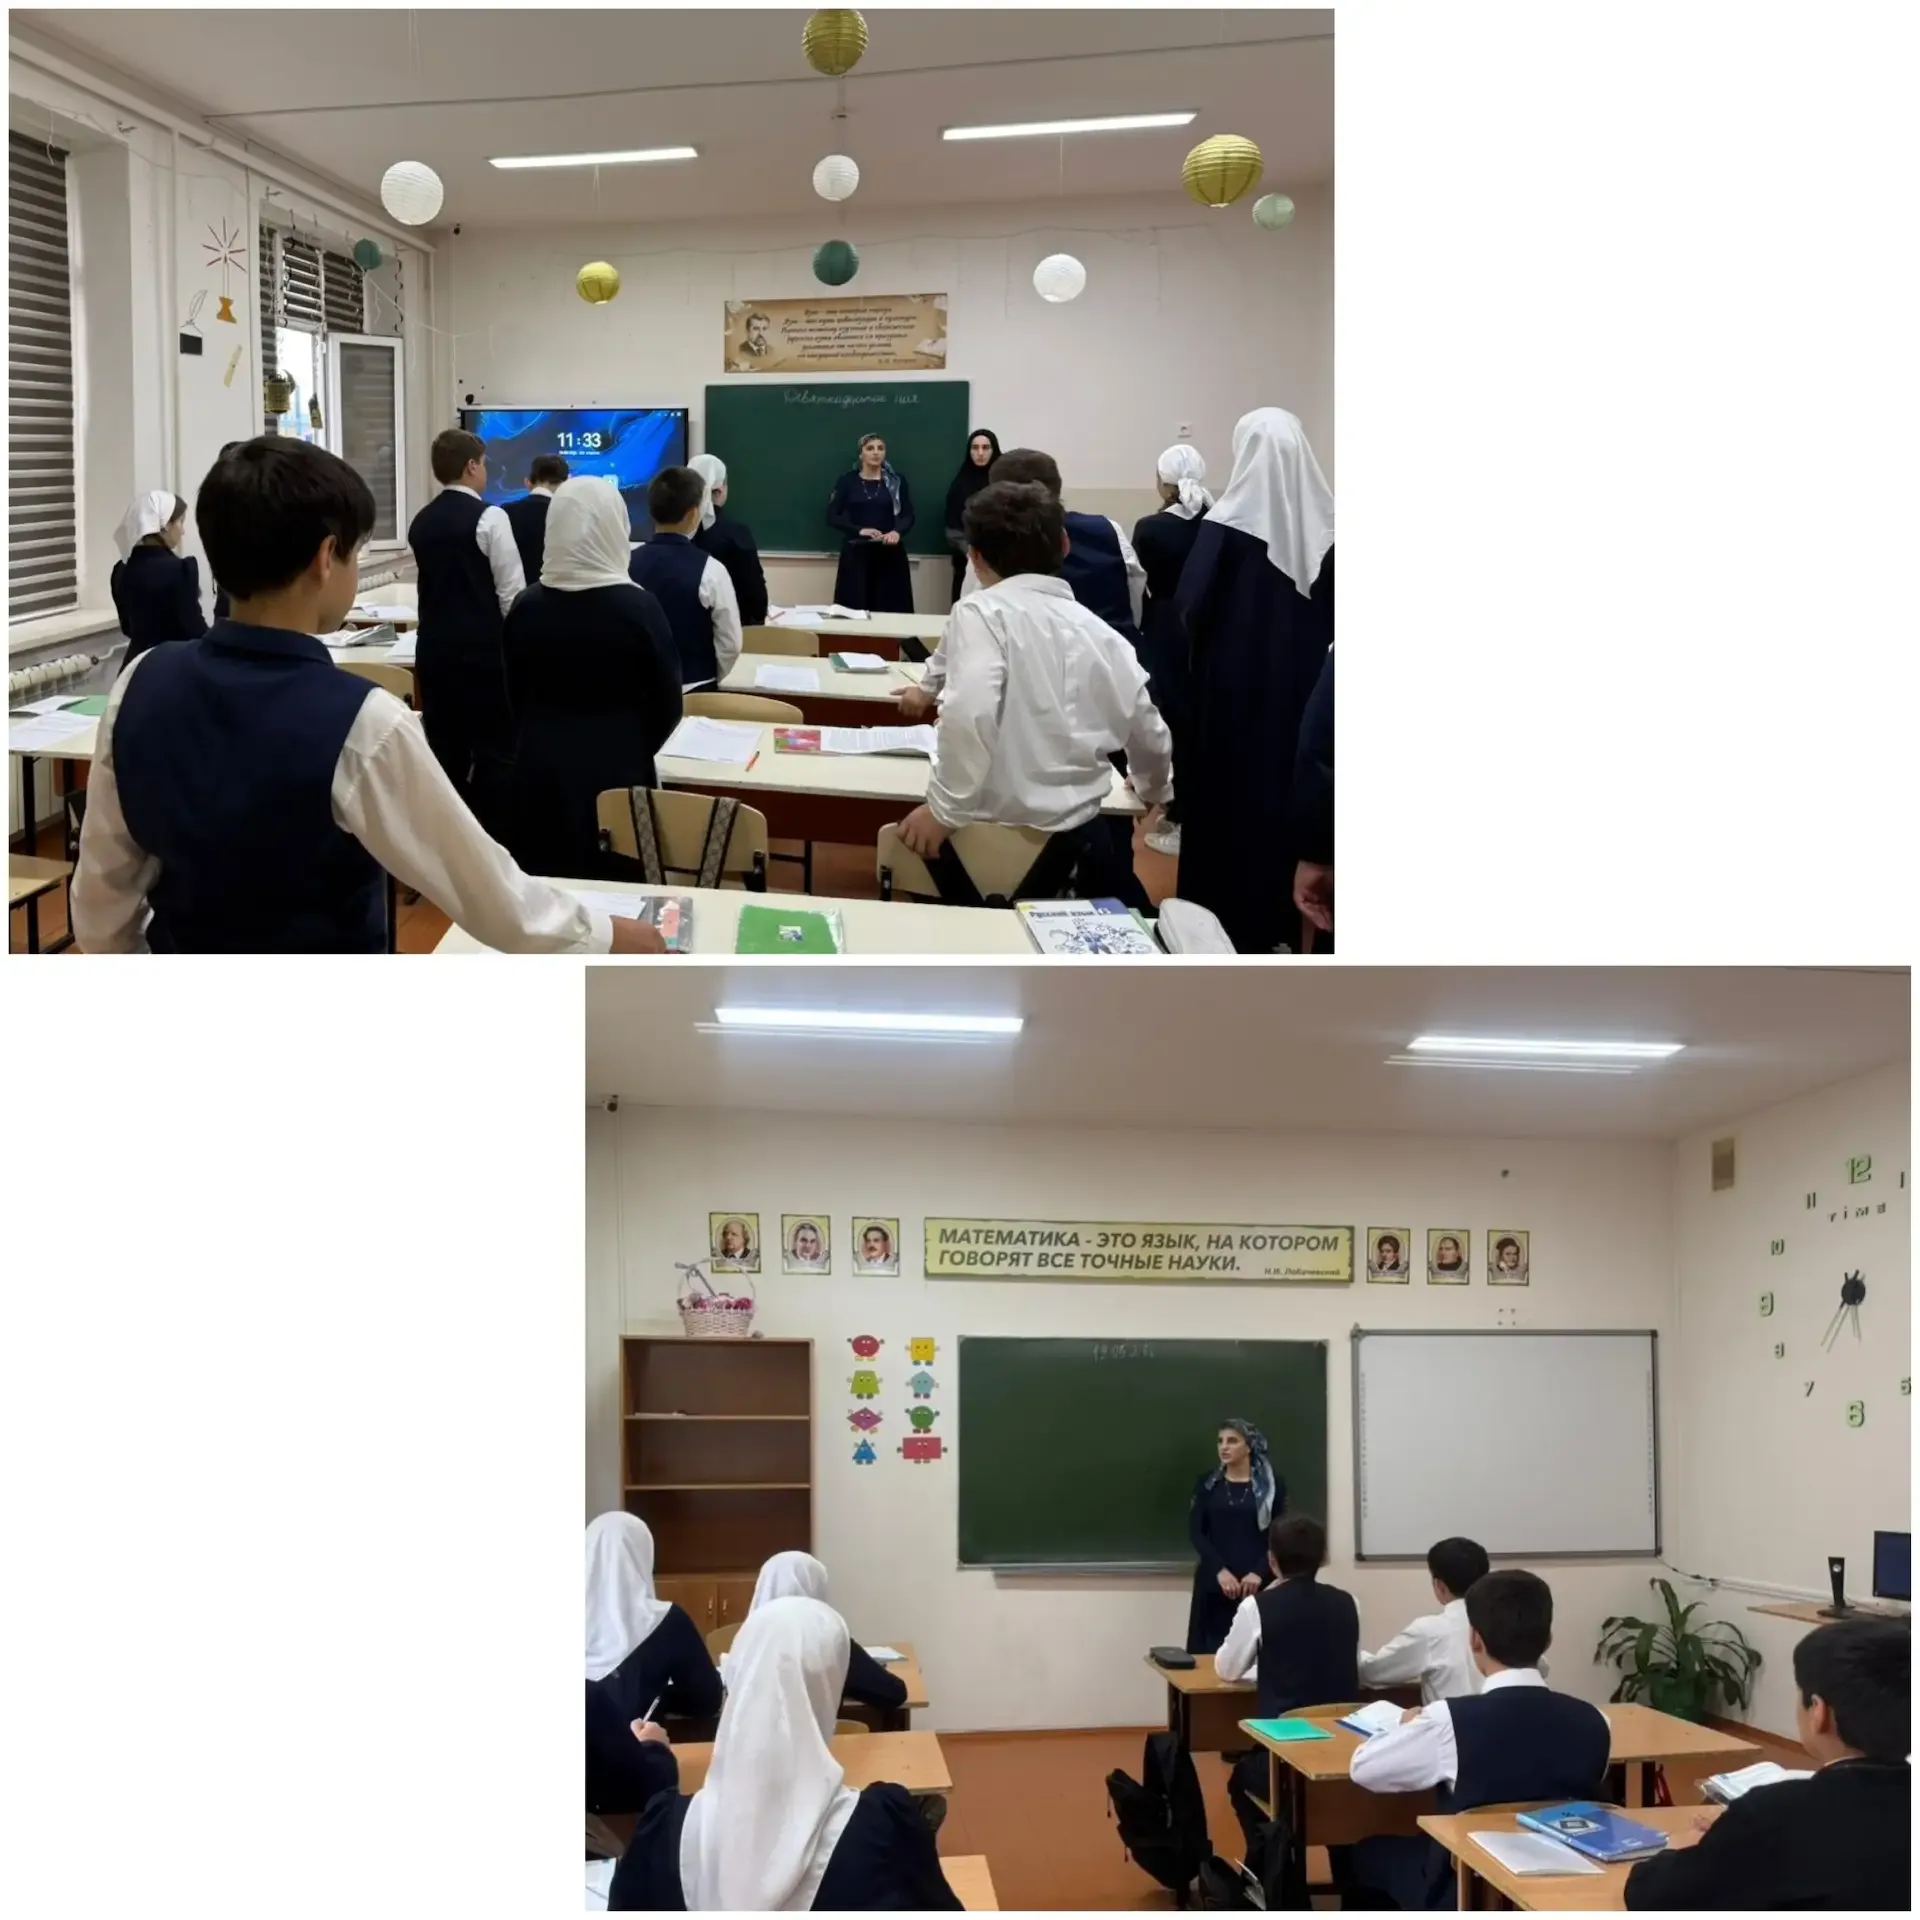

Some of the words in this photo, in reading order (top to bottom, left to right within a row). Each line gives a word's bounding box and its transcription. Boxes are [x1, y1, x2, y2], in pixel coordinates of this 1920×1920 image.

[557, 432, 601, 448] 11:33
[1846, 1155, 1872, 1185] 12
[1806, 1191, 1816, 1210] 11
[939, 1228, 1080, 1247] МАТЕМАТИКА
[1096, 1232, 1137, 1248] ЭТО
[1141, 1233, 1200, 1251] ЯЗЫК,
[1207, 1234, 1234, 1250] НА
[1239, 1235, 1339, 1251] КОТОРОМ
[939, 1250, 1033, 1267] ГОВОРЯТ
[1037, 1252, 1075, 1268] ВСЕ
[1080, 1253, 1163, 1270] ТОЧНЫЕ
[1168, 1255, 1240, 1271] НАУКИ.
